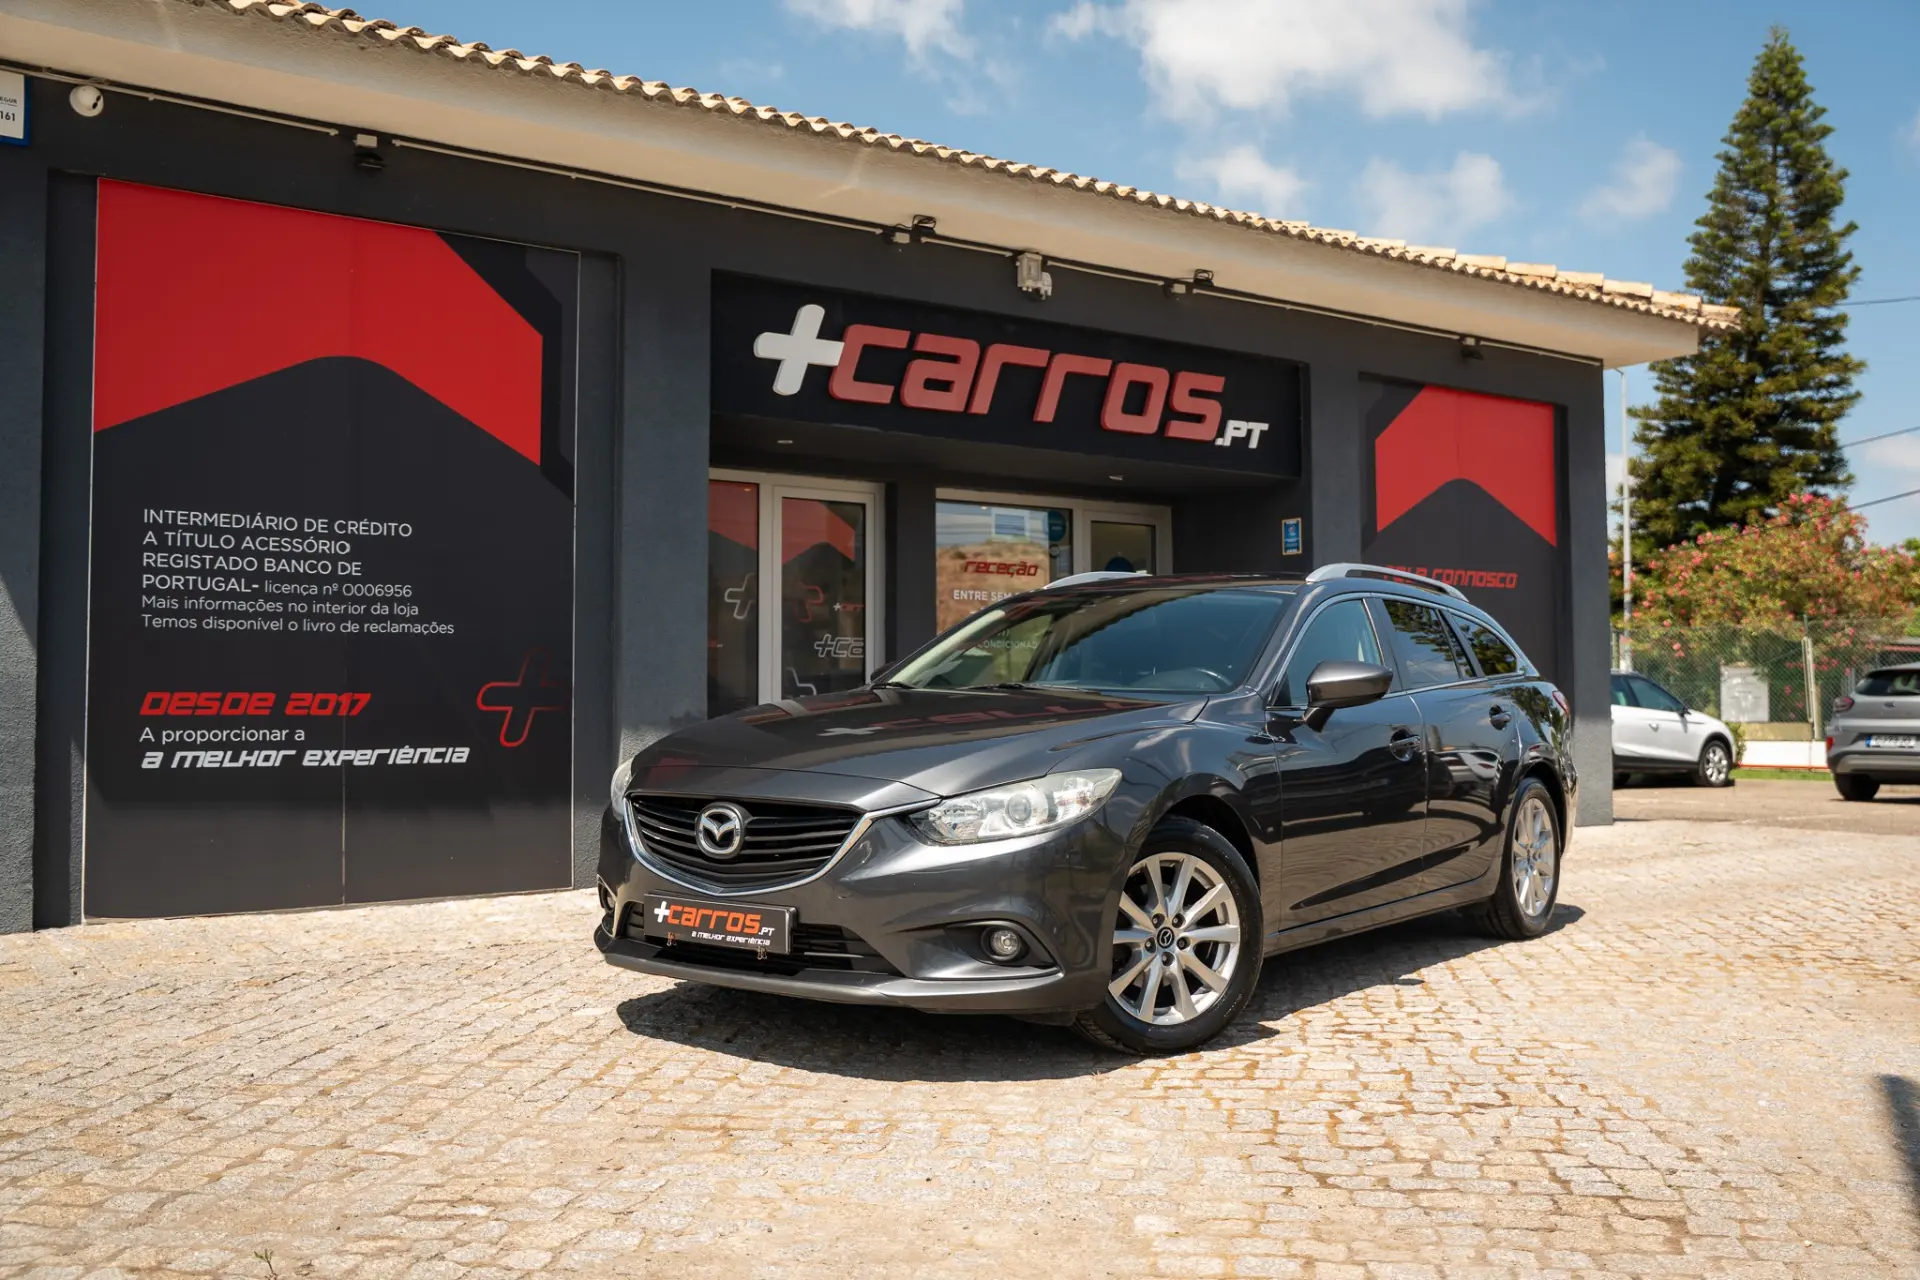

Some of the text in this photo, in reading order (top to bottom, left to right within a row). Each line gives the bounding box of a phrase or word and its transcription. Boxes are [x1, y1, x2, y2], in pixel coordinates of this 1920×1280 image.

[144, 509, 412, 537] INTERMEDIÁRIO DE CRÉDITO
[143, 529, 351, 554] A TÍTULO ACESSÓRIO
[143, 552, 362, 576] REGISTADO BANCO DE
[264, 580, 318, 597] licença
[343, 584, 412, 597] 0006956
[953, 590, 988, 601] ENTRE
[142, 595, 419, 618] Mais informações no interior da loja
[142, 614, 454, 636] Temos disponível o livro de reclamações
[285, 692, 371, 716] 2017
[140, 725, 305, 746] A proporcionar a
